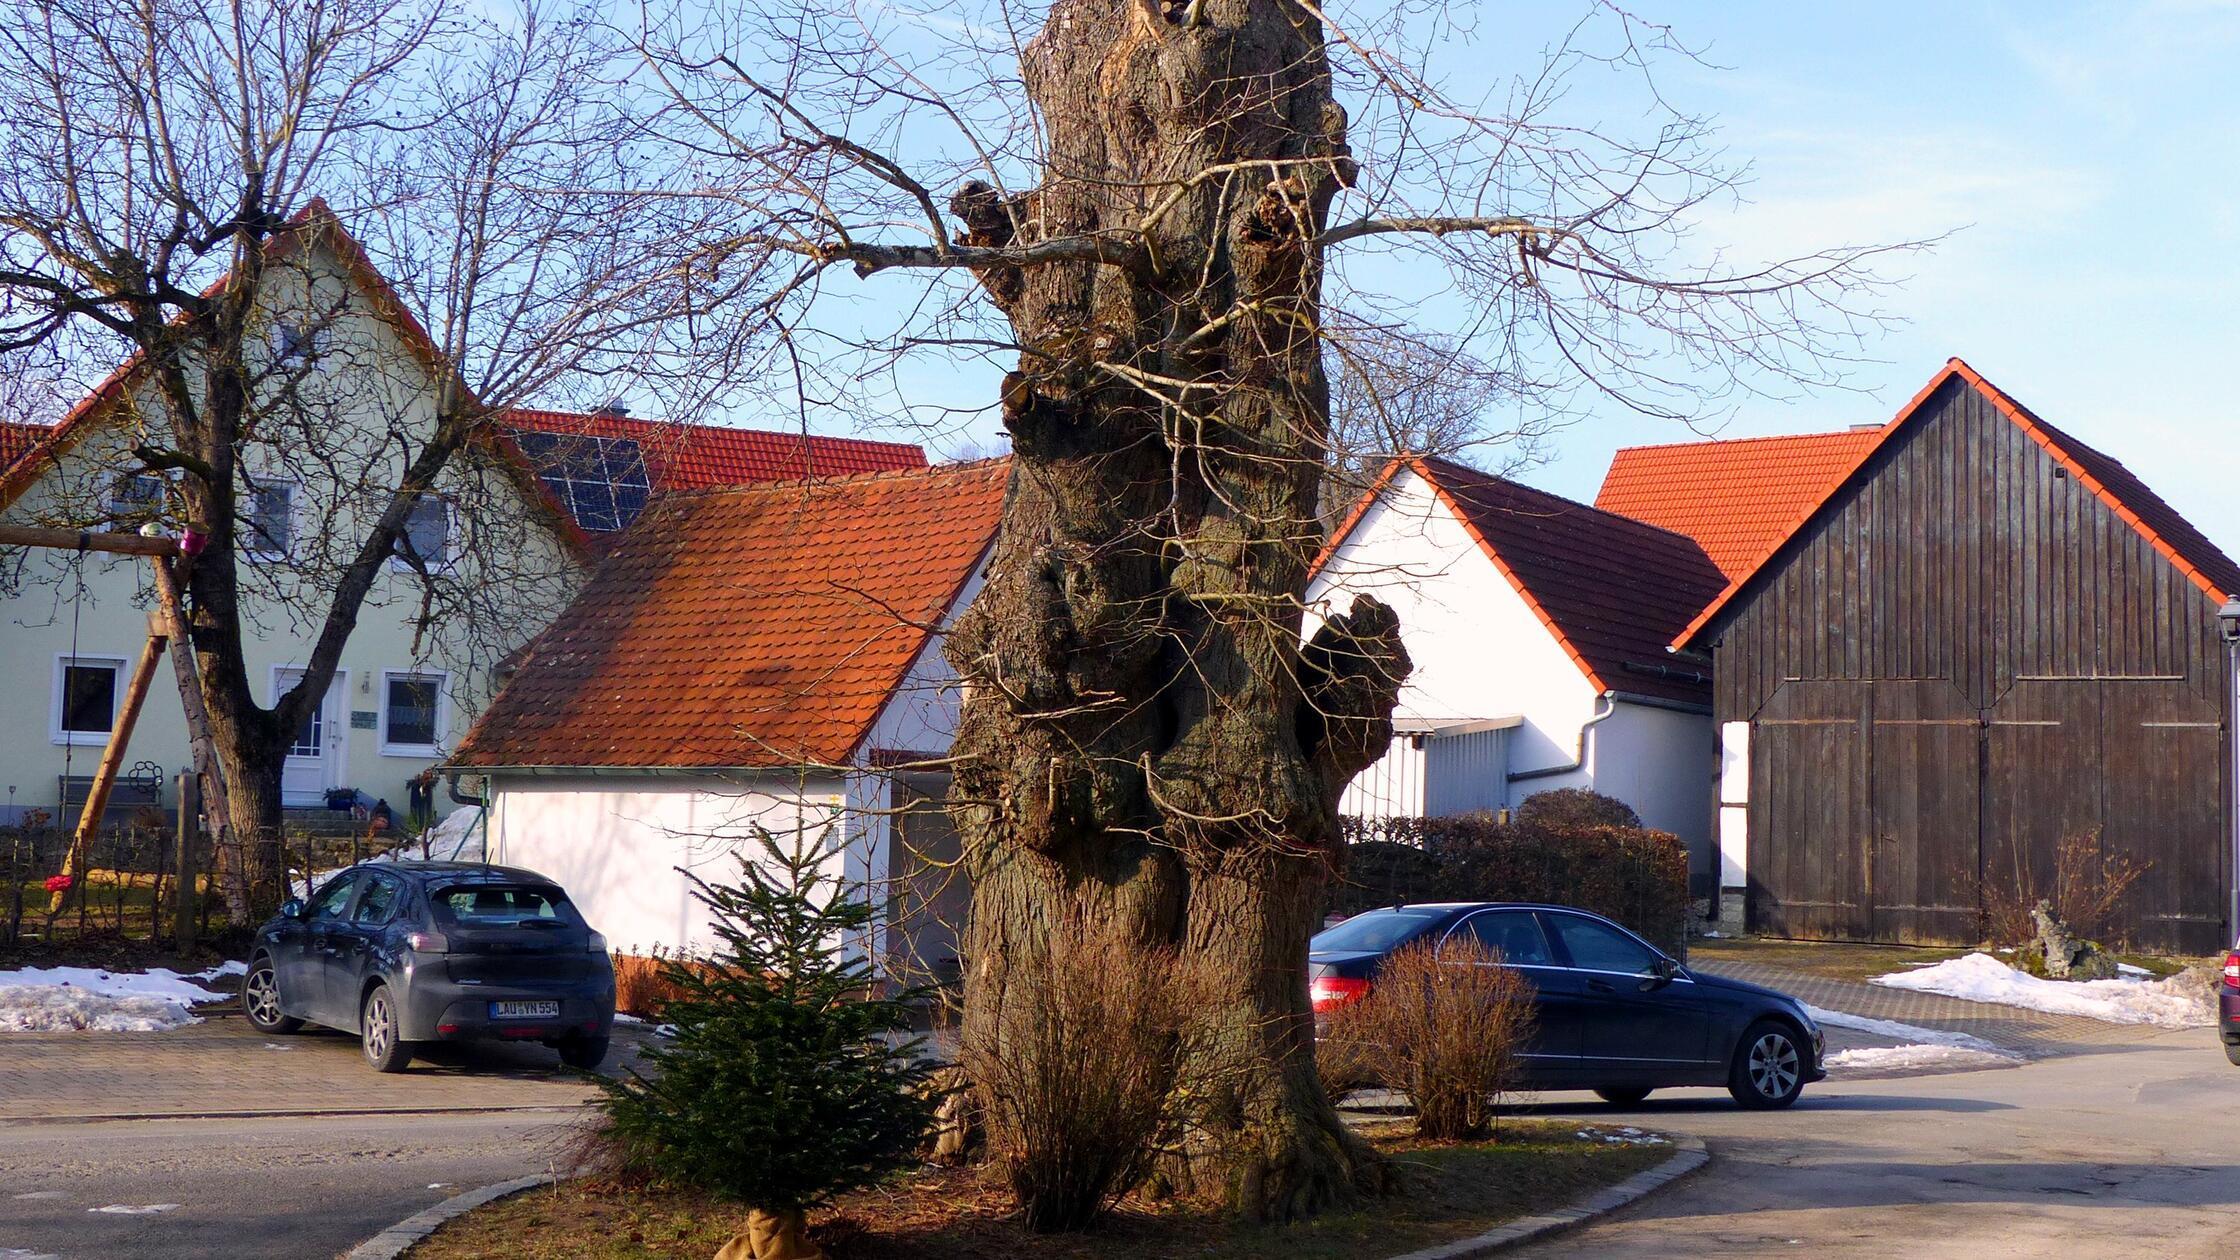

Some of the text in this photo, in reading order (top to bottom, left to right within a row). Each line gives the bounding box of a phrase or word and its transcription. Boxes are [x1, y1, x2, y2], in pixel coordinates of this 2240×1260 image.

[497, 1002, 558, 1015] LAU YN 554
